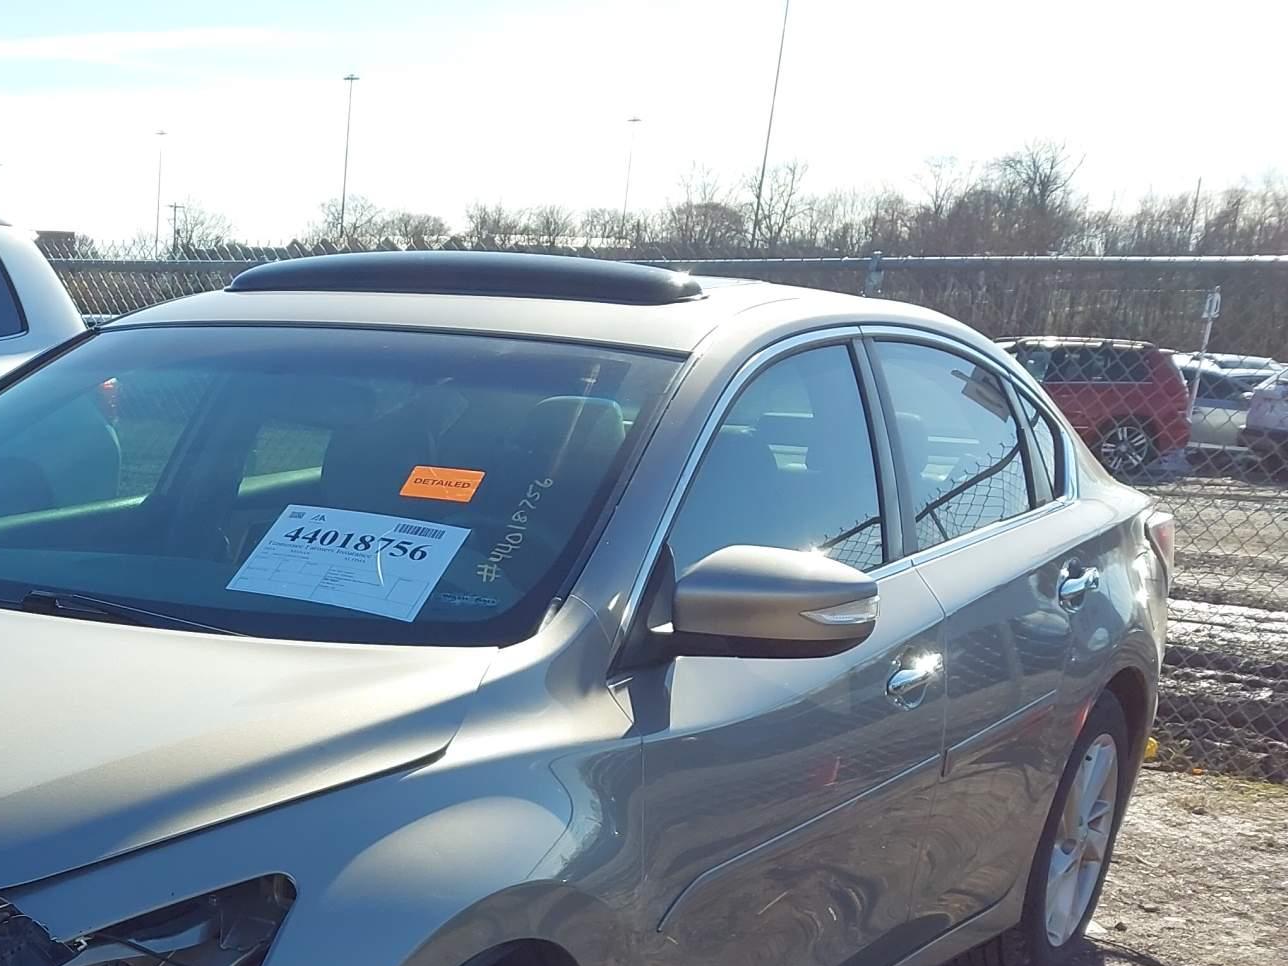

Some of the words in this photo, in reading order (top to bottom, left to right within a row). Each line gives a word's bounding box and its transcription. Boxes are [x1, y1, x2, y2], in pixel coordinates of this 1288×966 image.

[413, 478, 471, 489] DETAILED
[284, 526, 432, 561] 44018756
[476, 478, 554, 582] #44018756
